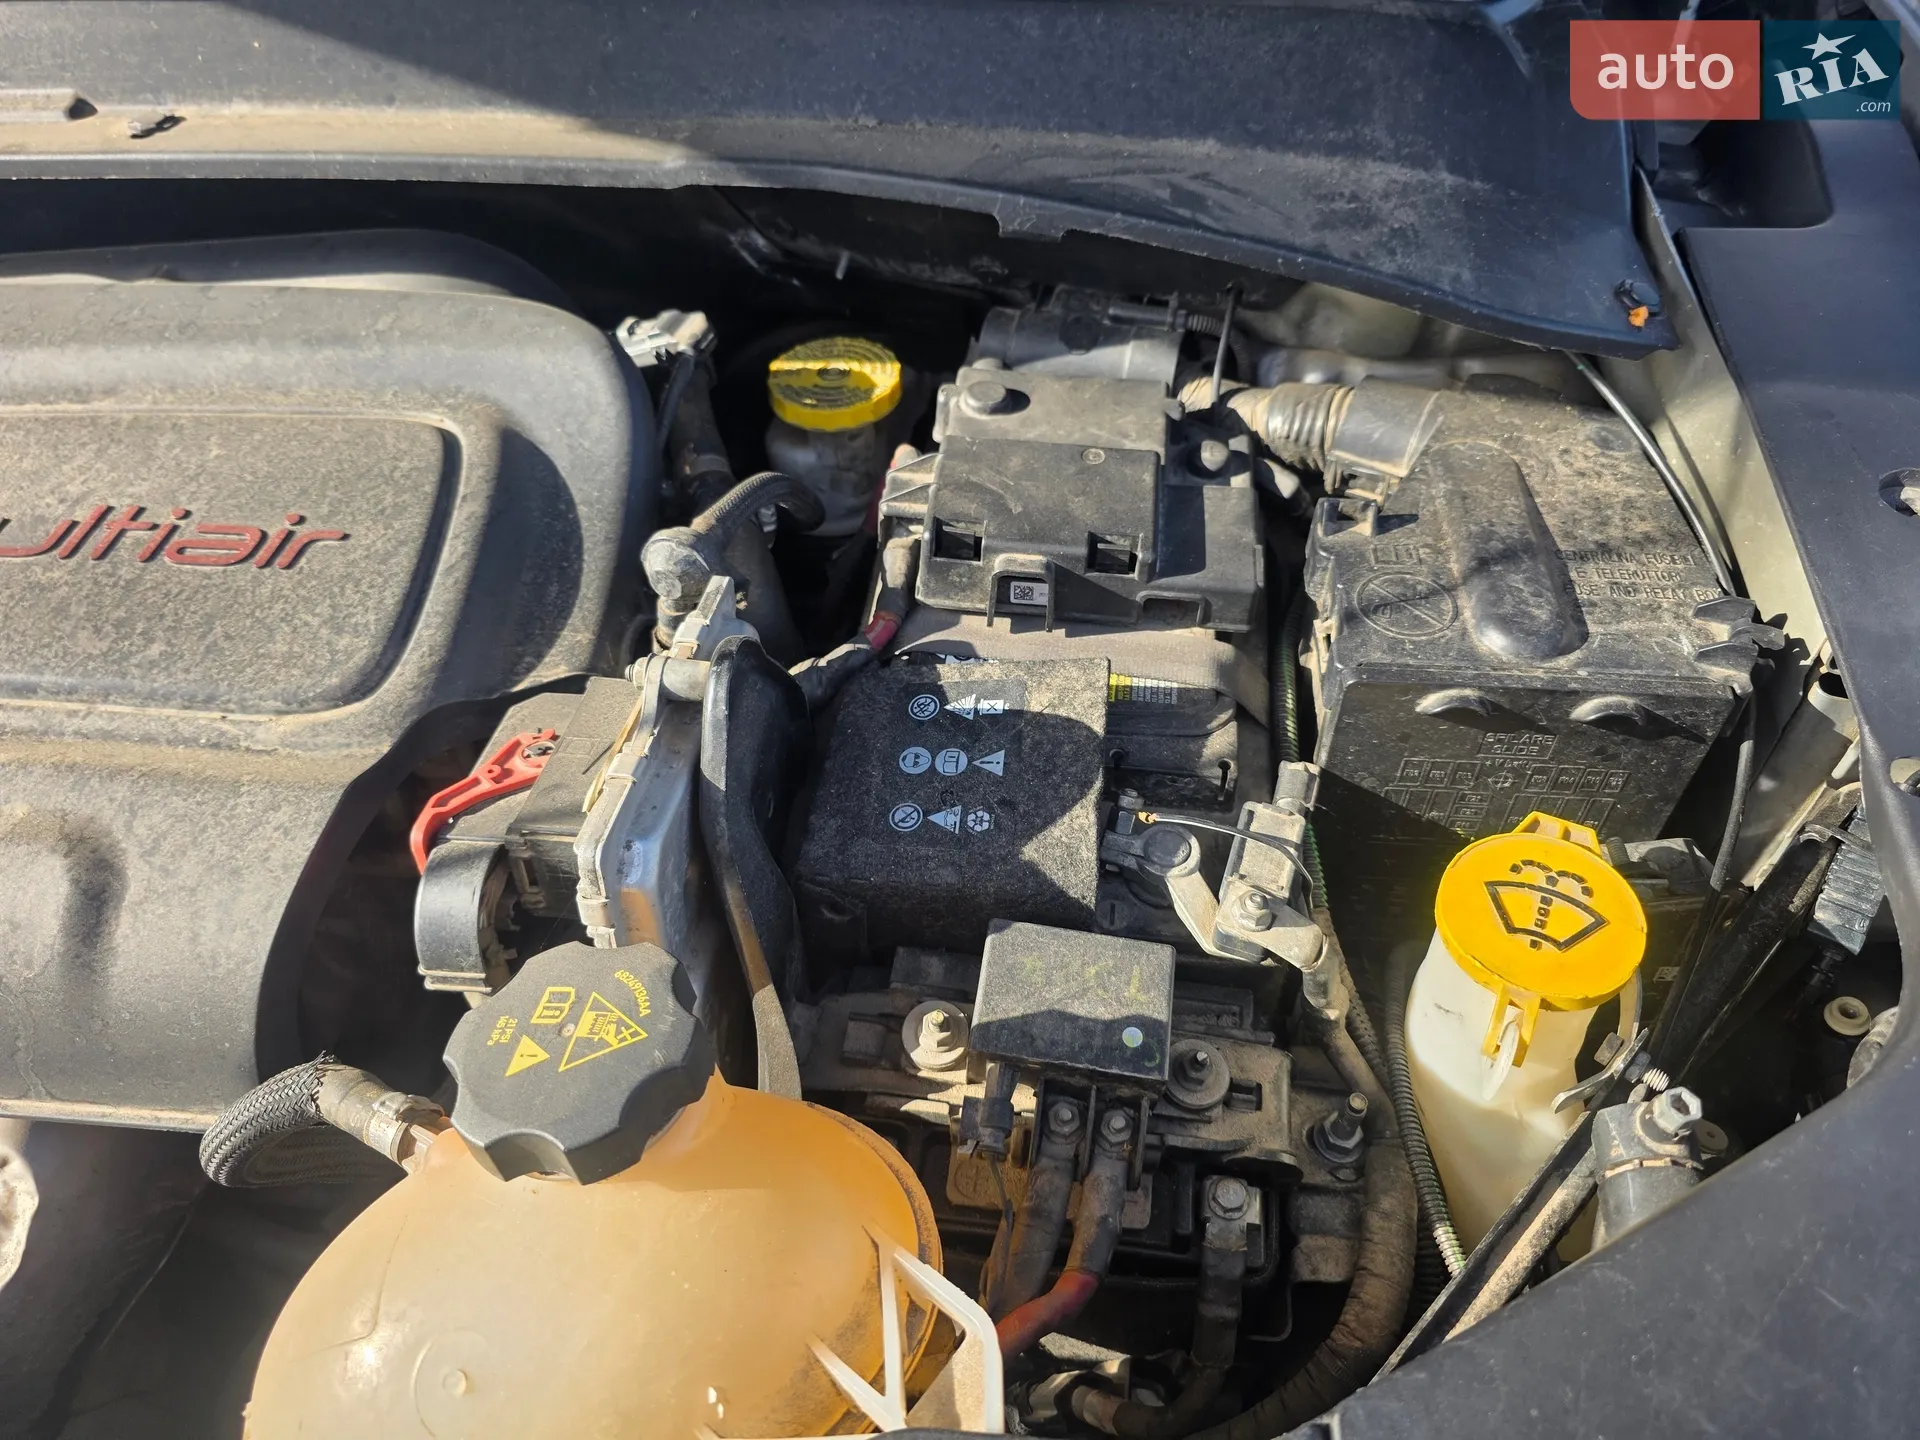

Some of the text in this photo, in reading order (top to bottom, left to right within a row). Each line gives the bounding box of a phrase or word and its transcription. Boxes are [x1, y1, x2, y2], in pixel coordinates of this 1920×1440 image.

[1609, 585, 1637, 598] AND
[1643, 587, 1686, 600] RELAY
[1491, 744, 1540, 756] SLIDE
[614, 969, 652, 1018] 68249136AA
[486, 1015, 509, 1046] 145 kPa
[498, 1018, 518, 1043] 21 PSI
